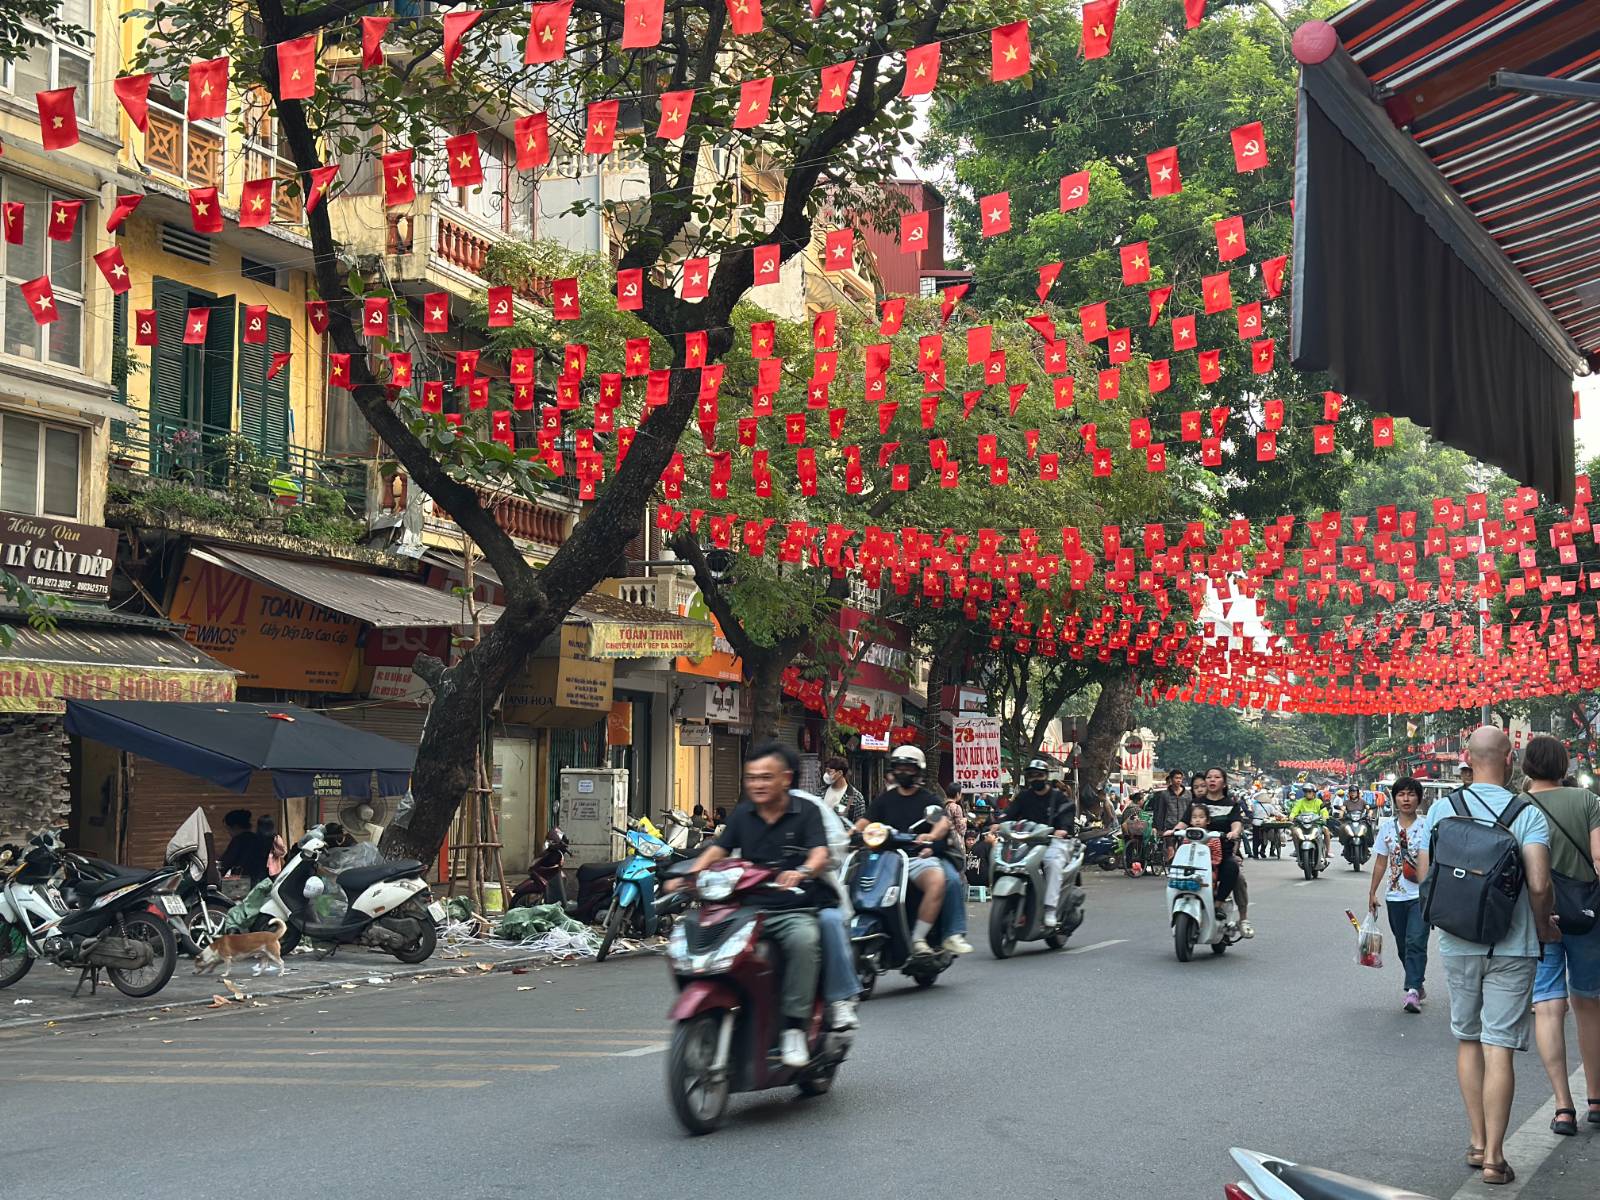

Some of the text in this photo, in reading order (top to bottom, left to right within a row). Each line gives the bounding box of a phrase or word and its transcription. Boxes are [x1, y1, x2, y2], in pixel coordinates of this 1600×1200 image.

[954, 727, 975, 743] 73
[985, 746, 999, 766] CUA
[956, 767, 979, 780] TÓP
